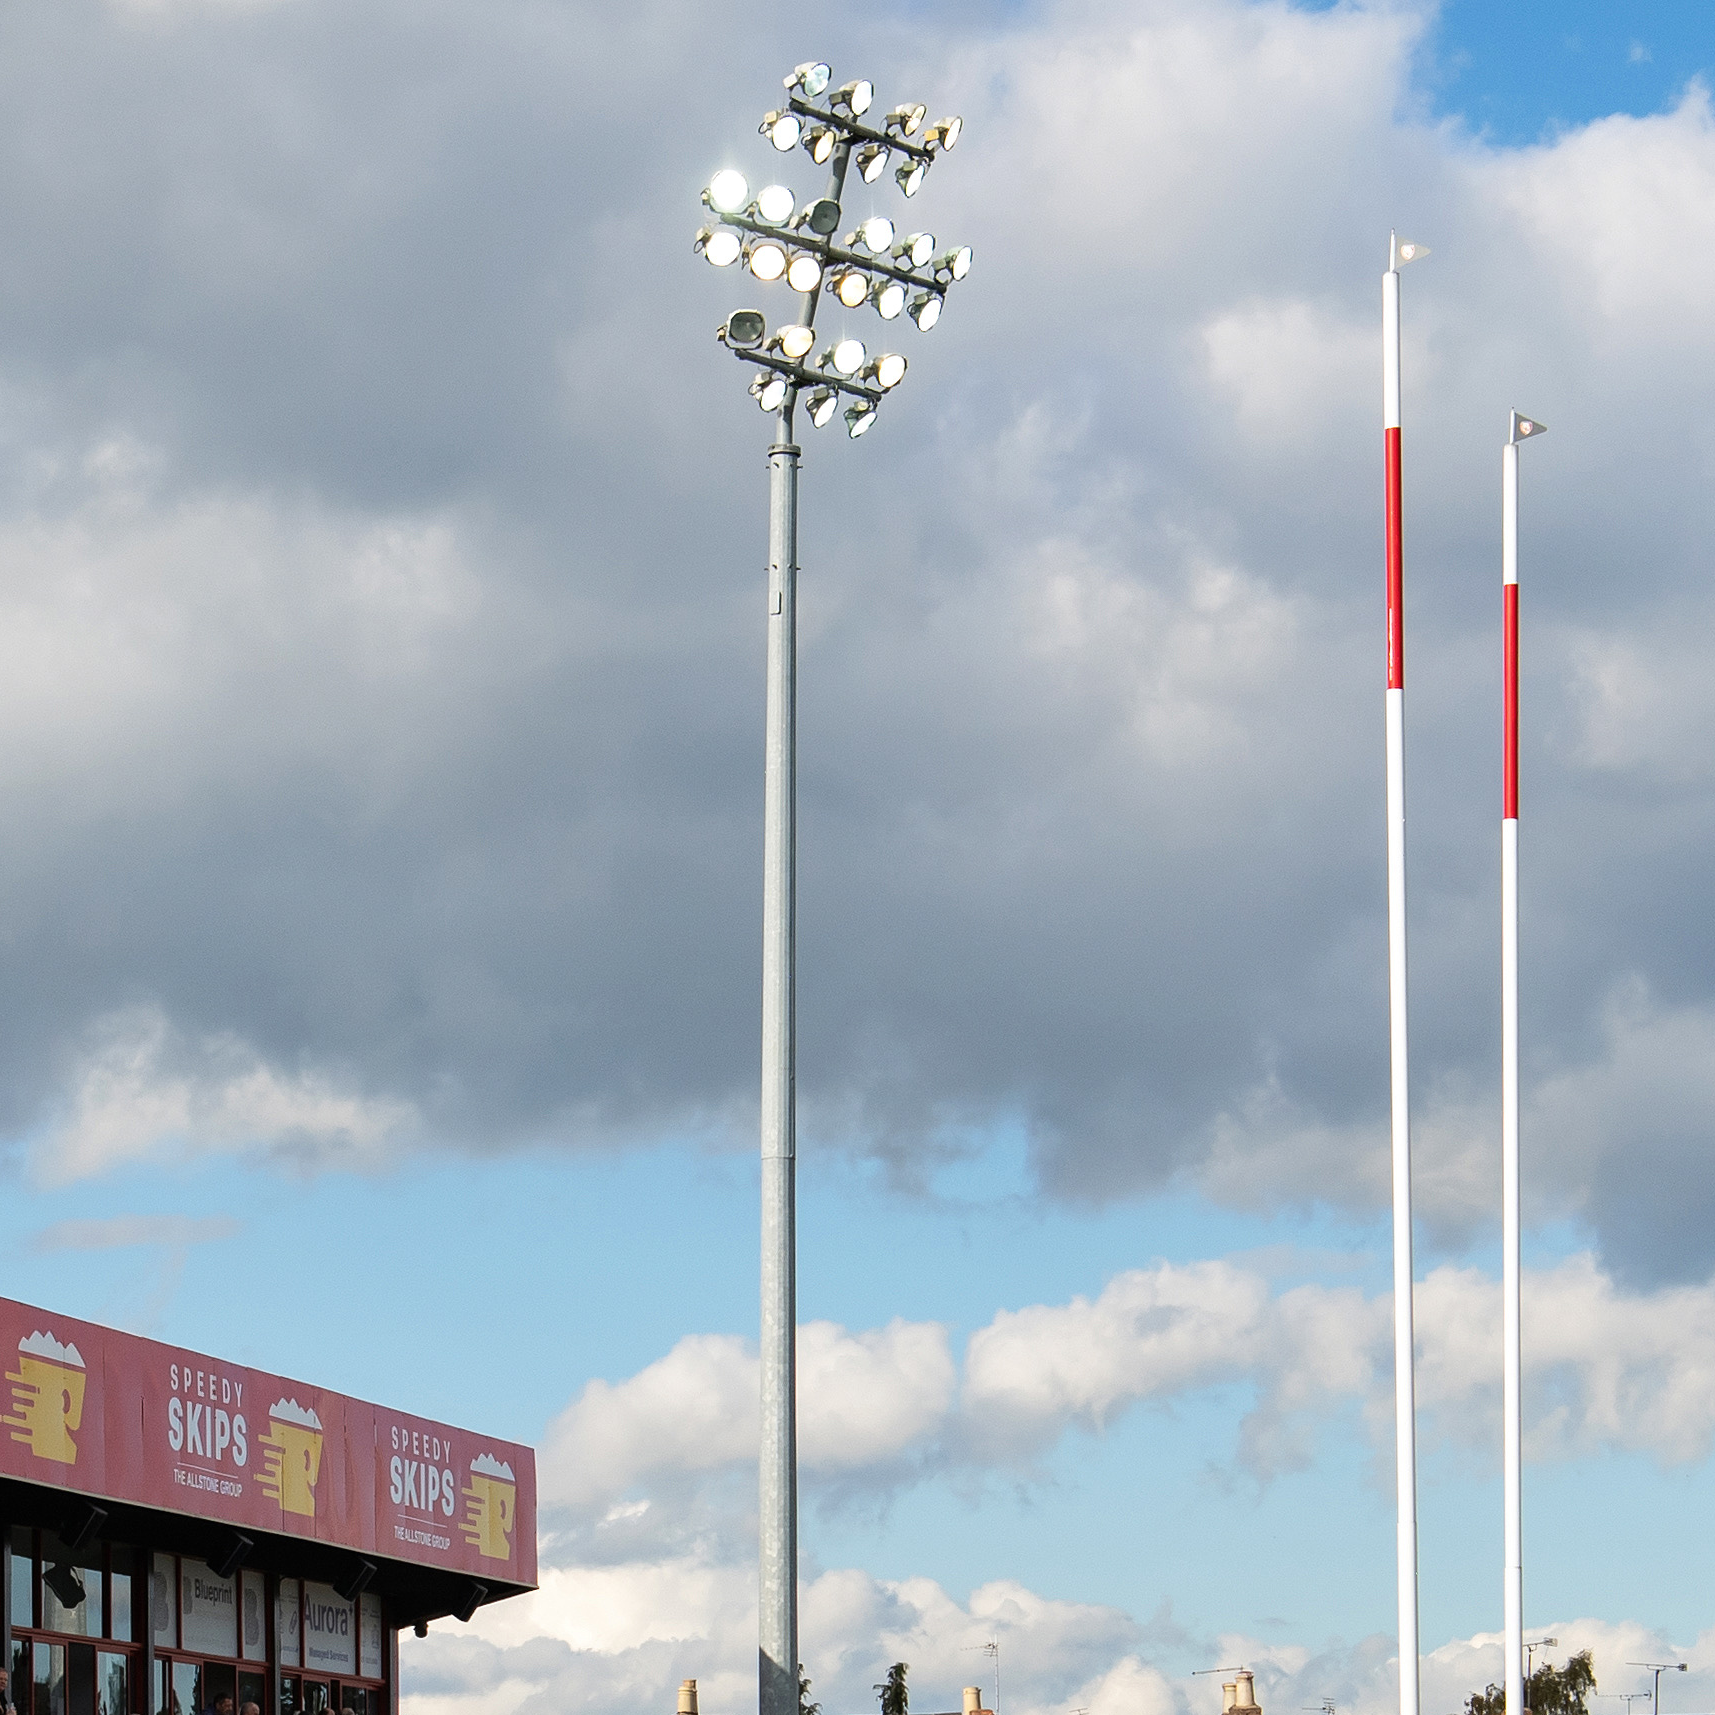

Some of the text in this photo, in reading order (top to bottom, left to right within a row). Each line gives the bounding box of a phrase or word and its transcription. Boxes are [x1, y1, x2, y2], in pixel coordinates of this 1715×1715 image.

[170, 1364, 243, 1407] SPEEDY
[168, 1397, 248, 1467] SKIPS
[391, 1425, 451, 1464] SPEEDY
[389, 1455, 455, 1517] SKIPS
[195, 1578, 233, 1607] Blueprint
